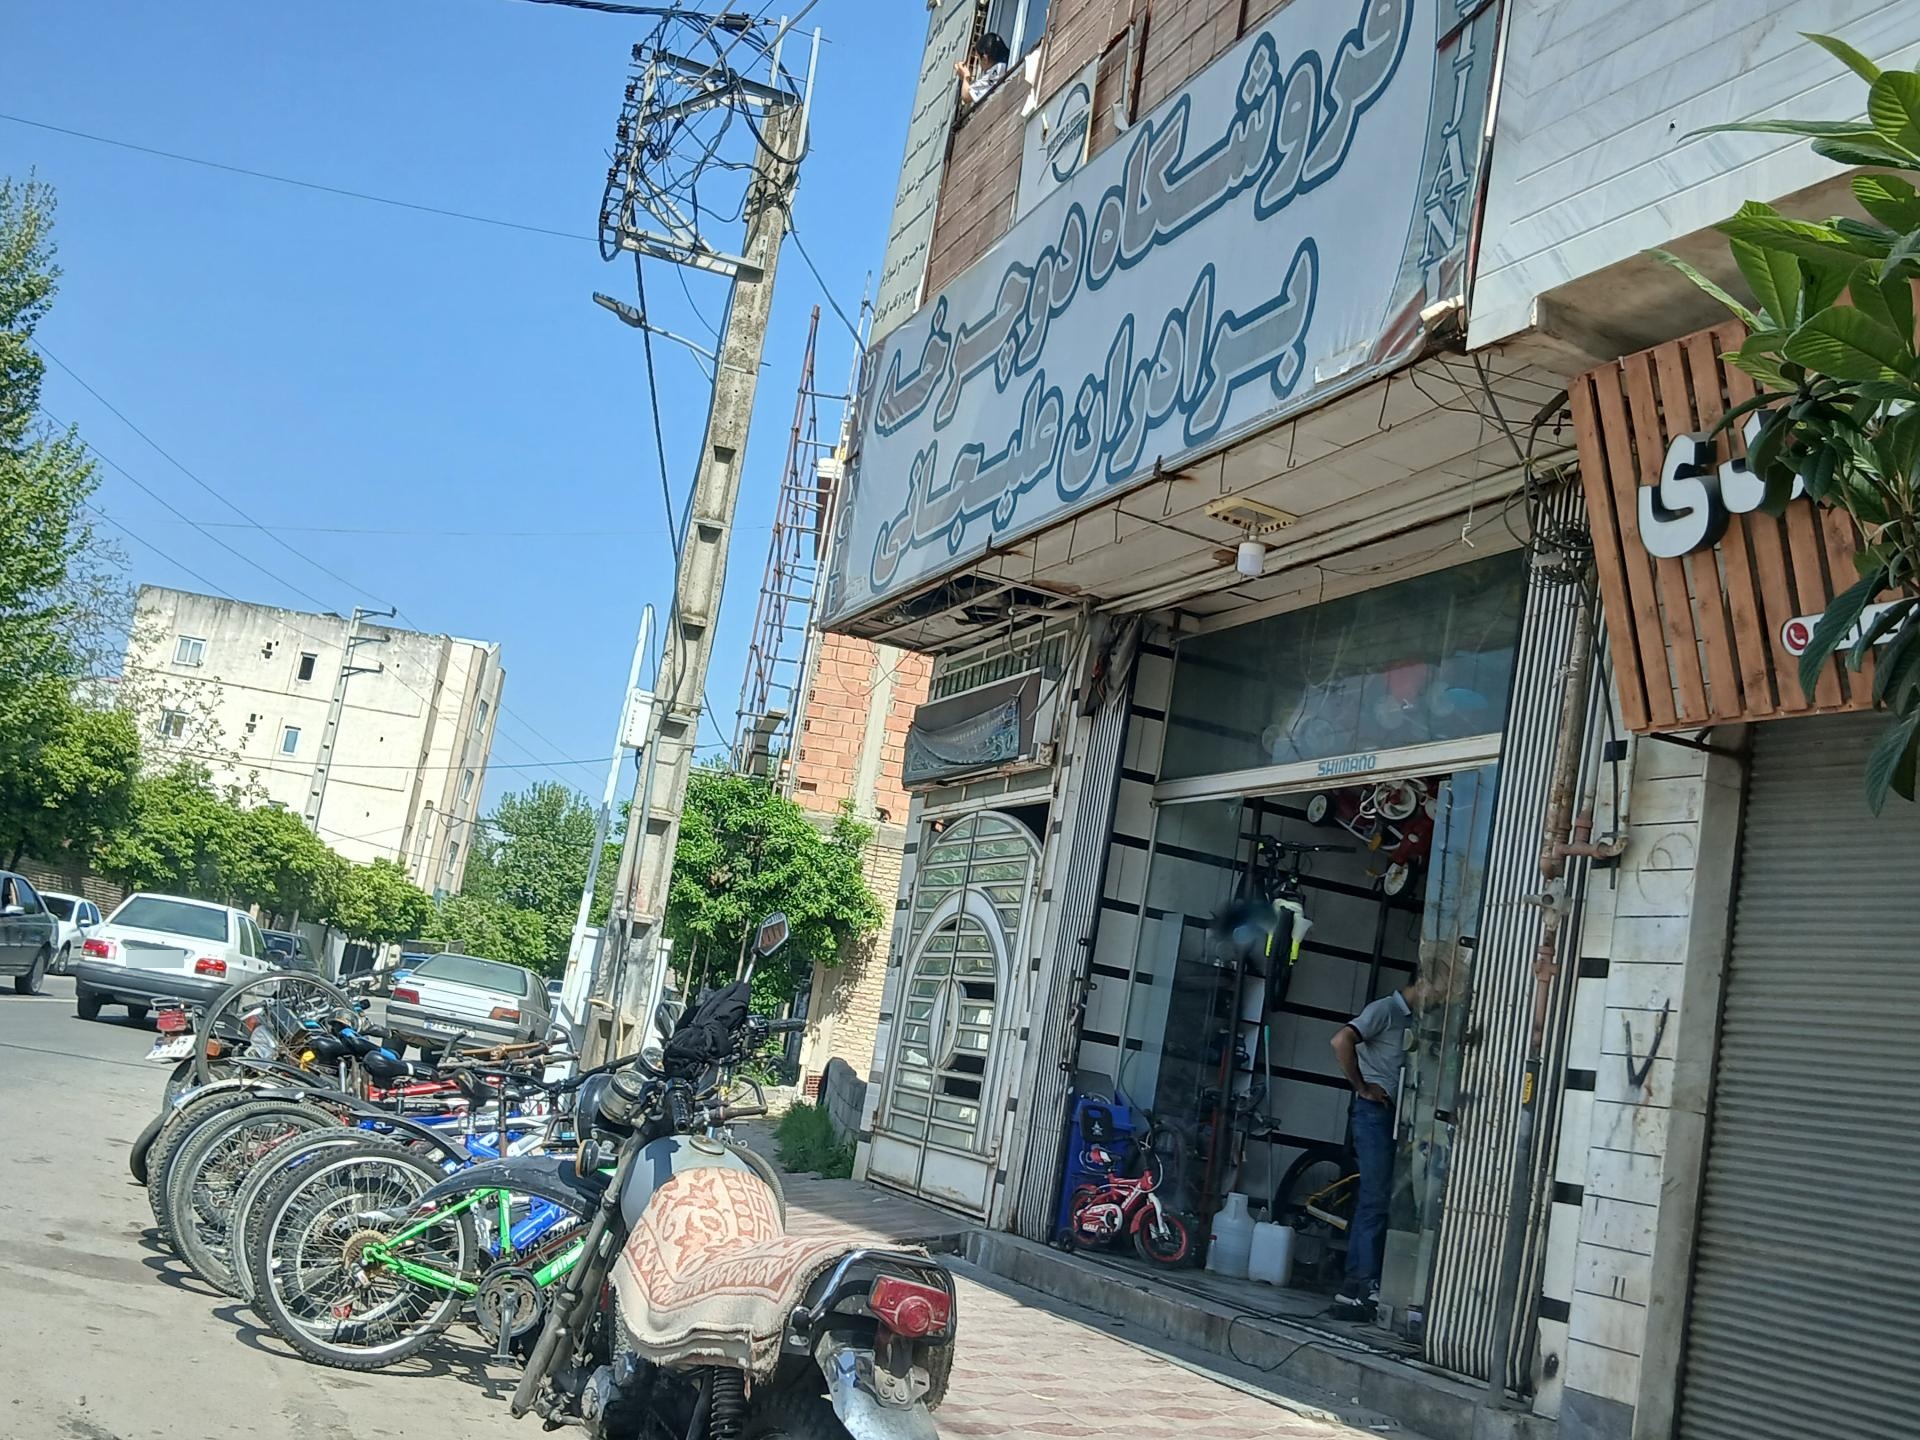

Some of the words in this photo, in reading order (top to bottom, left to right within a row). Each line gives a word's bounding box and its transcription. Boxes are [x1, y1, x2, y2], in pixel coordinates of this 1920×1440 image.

[1085, 0, 1414, 291] فروشگاه
[874, 201, 1087, 438] دوچرخه
[1056, 236, 1319, 502] برادران
[870, 368, 1066, 594] علیجانی
[1317, 754, 1377, 776] SHIMANO
